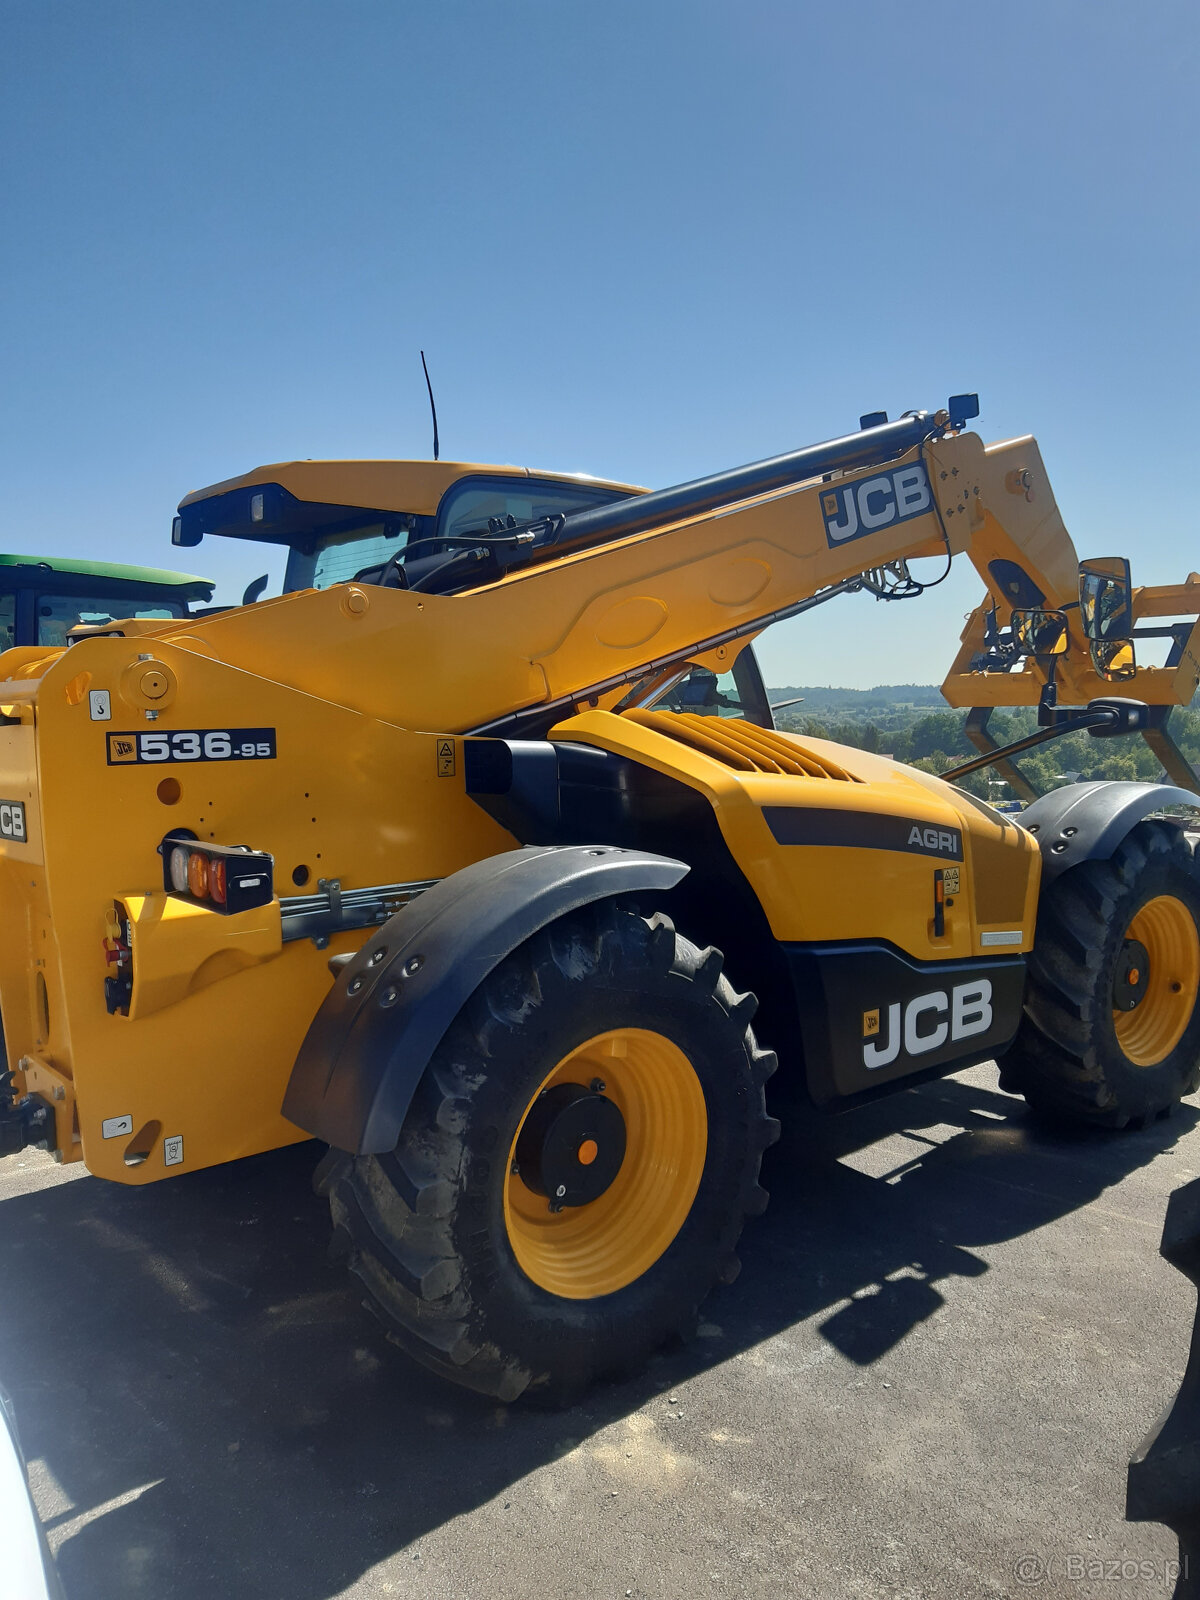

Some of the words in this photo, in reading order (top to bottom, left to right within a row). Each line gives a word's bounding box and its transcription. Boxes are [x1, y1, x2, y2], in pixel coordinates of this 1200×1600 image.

[828, 466, 930, 541] JCB
[116, 741, 133, 755] JCB
[0, 805, 24, 837] CB
[907, 826, 957, 853] AGRI
[864, 979, 992, 1068] JCB
